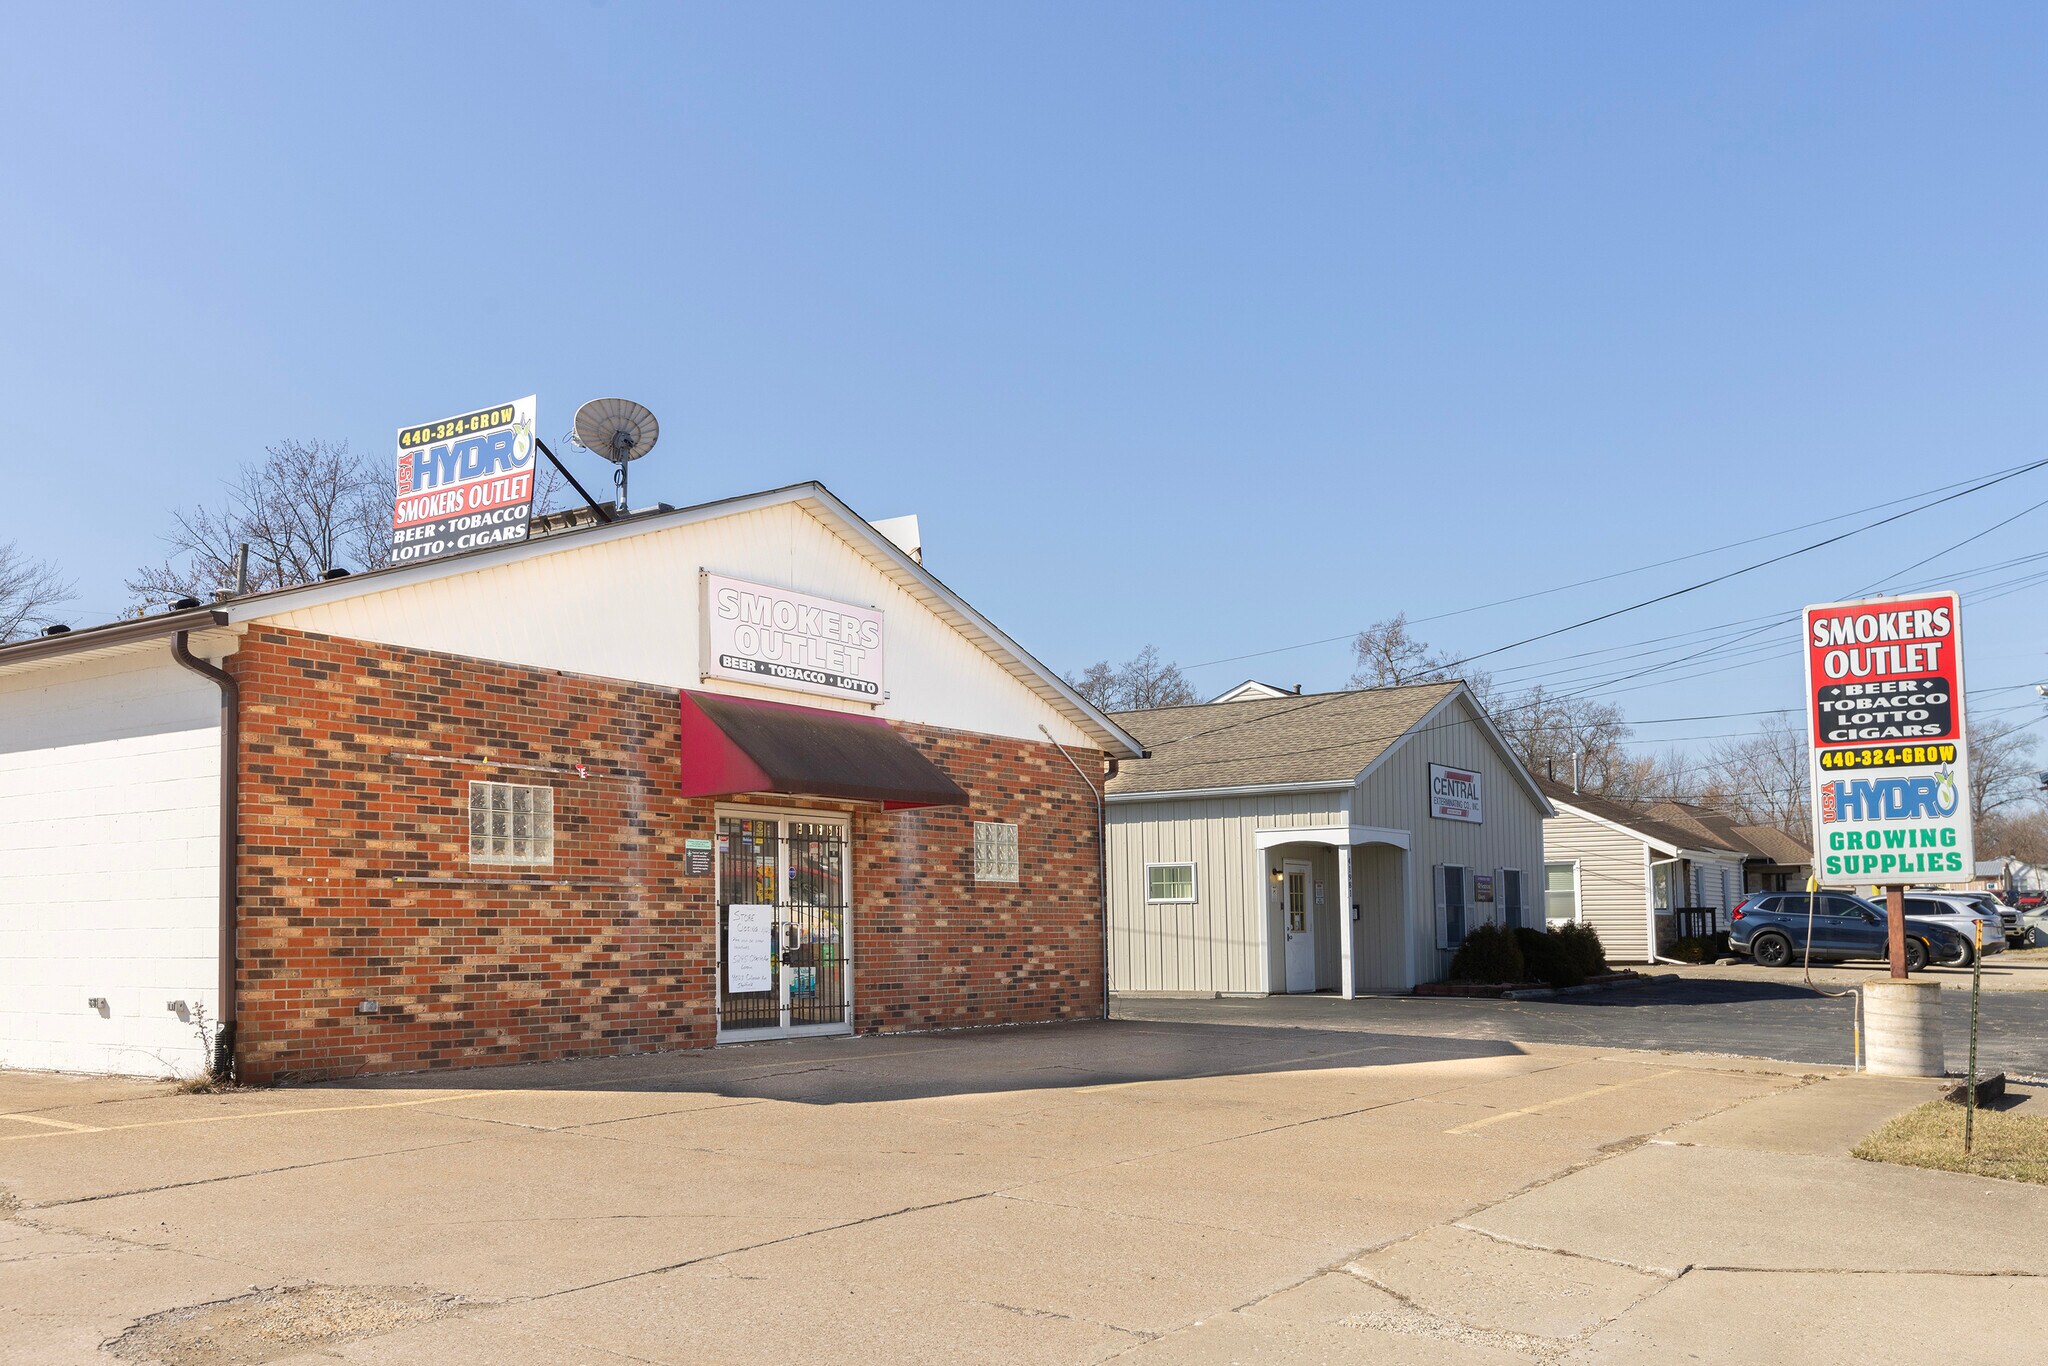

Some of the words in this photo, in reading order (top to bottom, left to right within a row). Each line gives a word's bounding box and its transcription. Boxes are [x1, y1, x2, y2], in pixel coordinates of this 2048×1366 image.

[402, 407, 513, 446] 440-324-GROW
[398, 452, 413, 496] USA
[396, 486, 464, 524] SMOKERS
[468, 473, 531, 507] OUTLET
[391, 540, 444, 562] LOTTO
[457, 523, 526, 549] CIGARS
[394, 524, 436, 544] BEER
[448, 504, 530, 532] TOBACCO
[717, 587, 880, 649] SMOKERS
[1813, 606, 1952, 648] SMOKERS
[734, 624, 866, 676] OUTLET
[1823, 641, 1943, 679] OUTLET
[722, 655, 756, 672] BEER
[768, 664, 826, 684] TOBACCO
[837, 676, 876, 694] LOTTO
[1845, 680, 1918, 696] BEER
[1819, 692, 1948, 712] TOBACCO
[1838, 709, 1929, 726] LOTTO
[1828, 724, 1942, 741] CIGARS
[1821, 745, 1955, 768] 440-324-GROW
[1433, 776, 1479, 800] CENTRAL
[1433, 796, 1463, 809] EXTERMINATING
[1822, 781, 1836, 824] USA
[1829, 827, 1957, 851] GROWING
[1826, 852, 1963, 875] SUPPLIES
